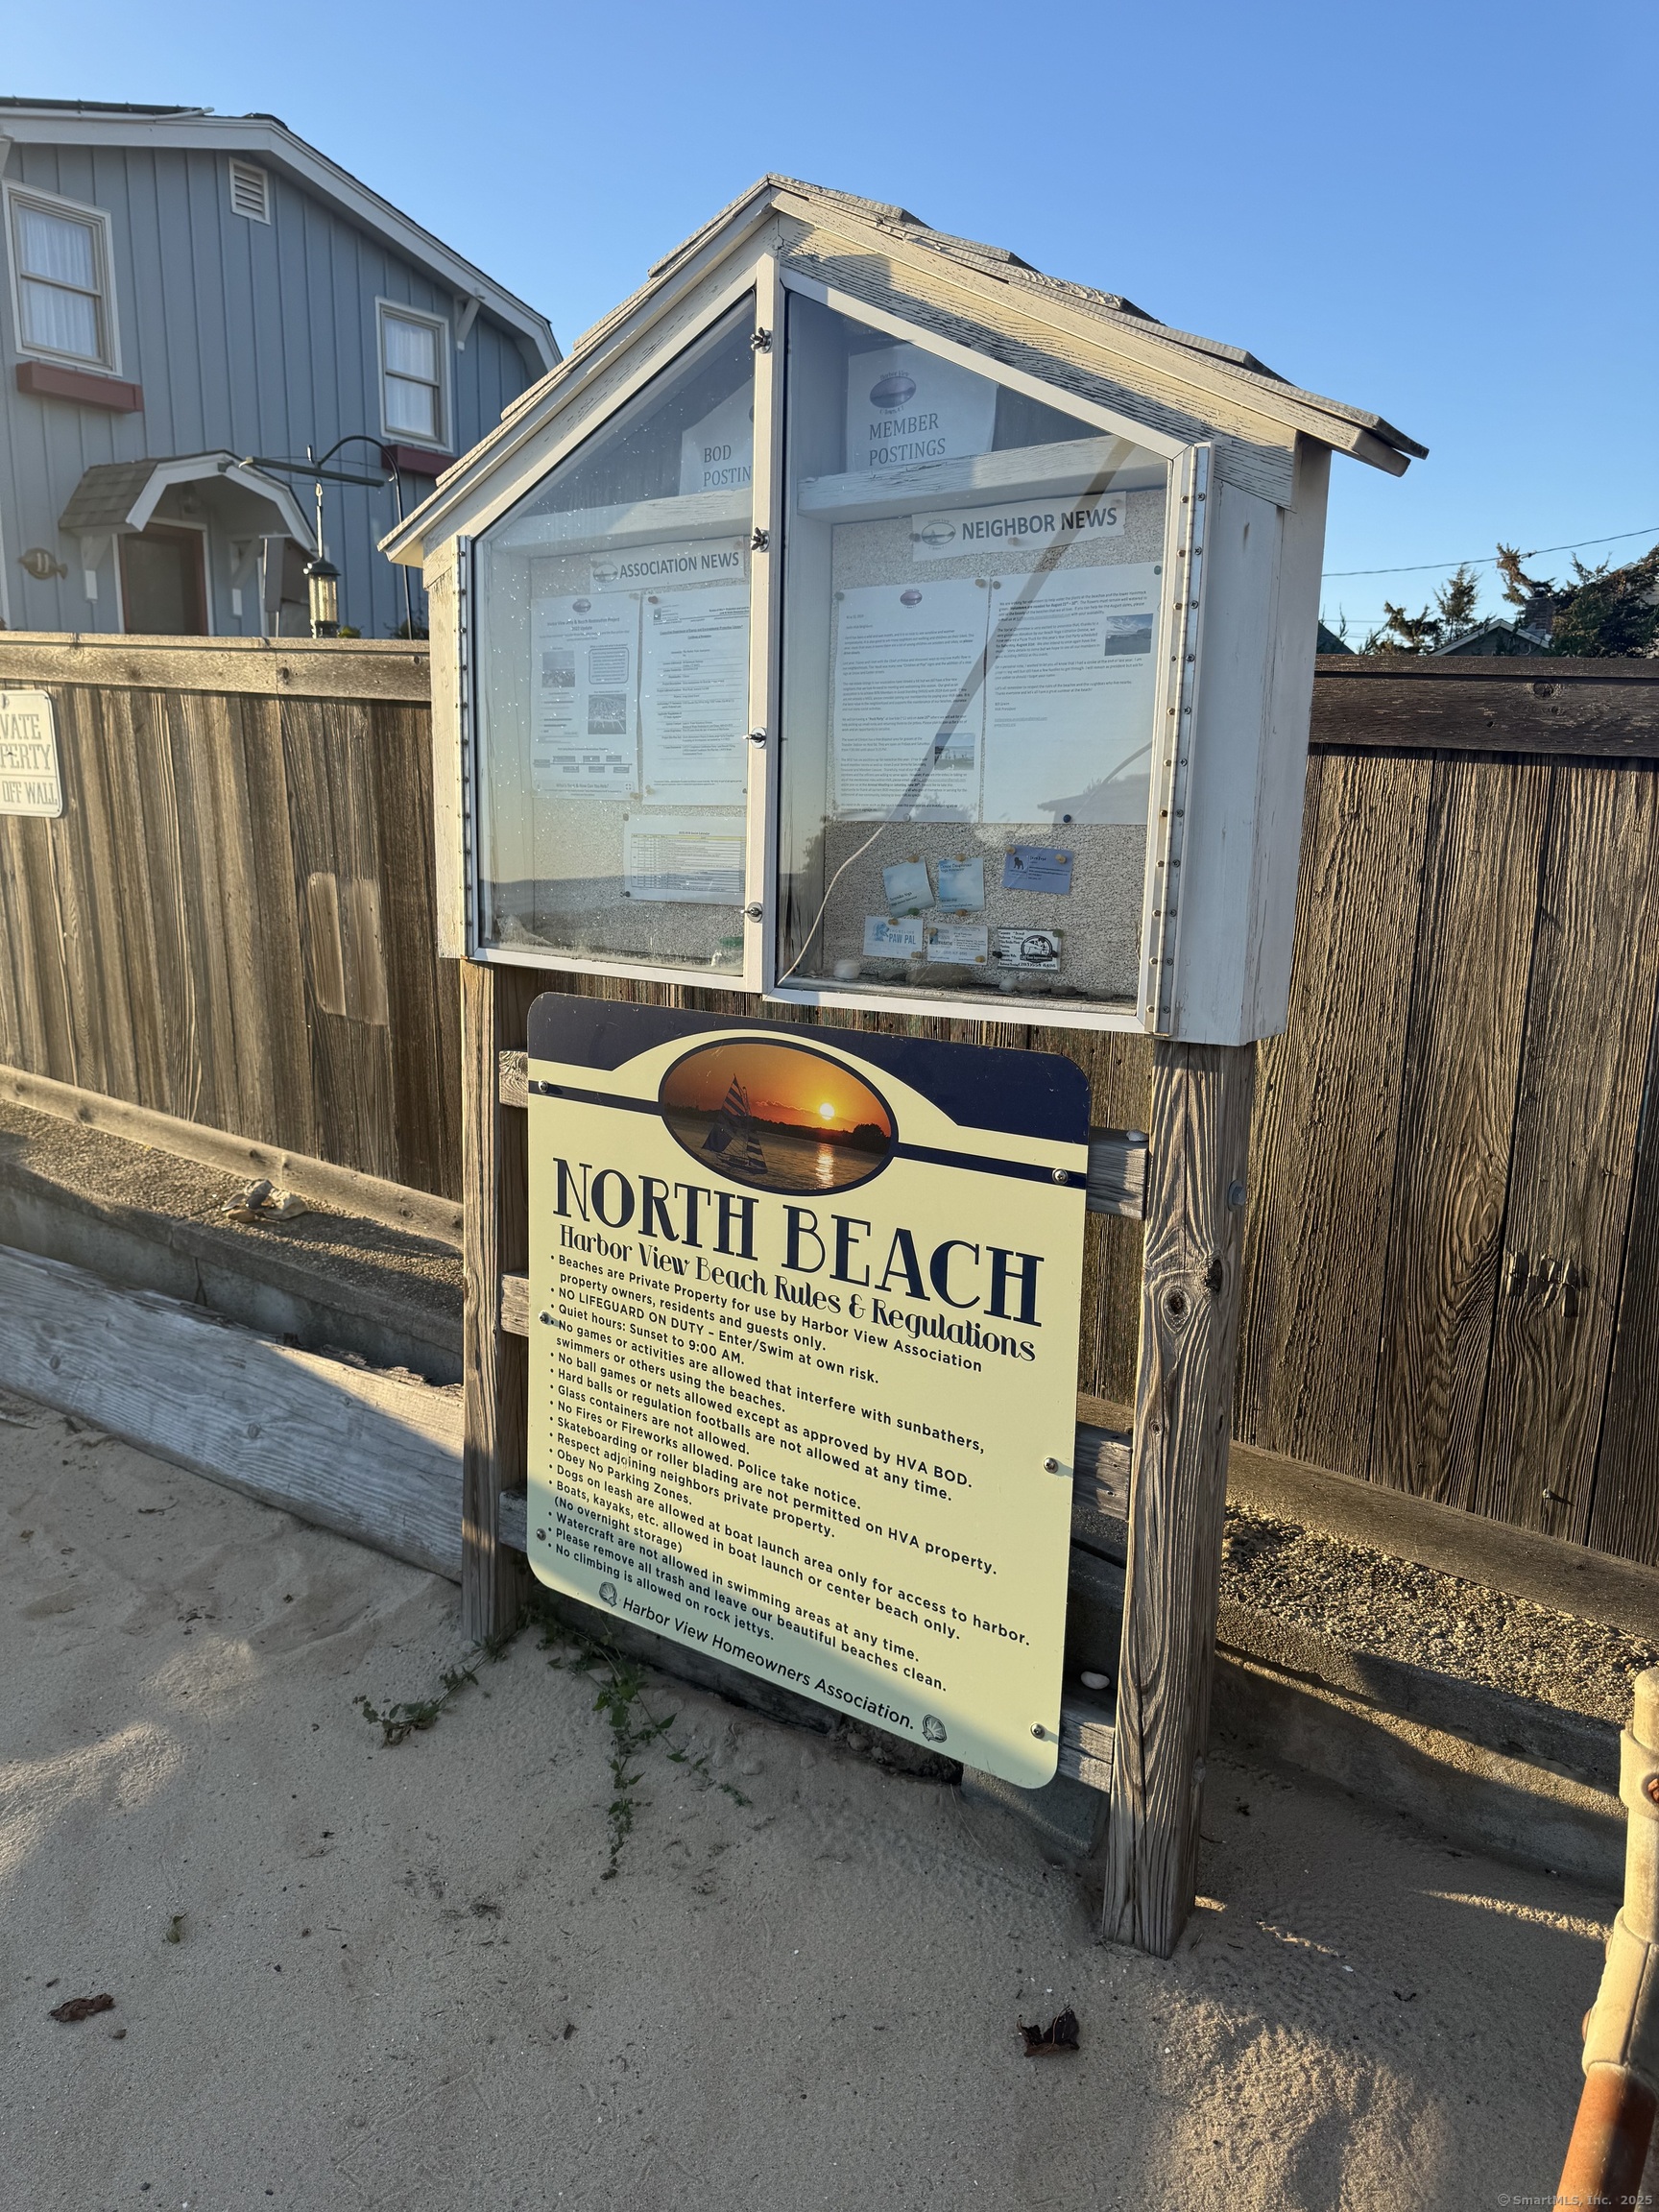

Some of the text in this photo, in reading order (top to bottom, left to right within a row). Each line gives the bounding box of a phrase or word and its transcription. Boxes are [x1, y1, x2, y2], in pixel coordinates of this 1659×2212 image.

[704, 445, 732, 463] BOD
[869, 438, 946, 467] POSTINGS
[870, 413, 939, 441] MEMBER
[704, 466, 753, 487] POSTIN
[962, 507, 1118, 541] NEIGHBOR NEWS
[619, 552, 739, 579] ASSOCIATION NEWS
[0, 713, 41, 740] VATE
[0, 743, 51, 771] PERTY
[2, 781, 58, 805] OFF WALL
[889, 933, 916, 945] PAW PAL
[552, 1156, 1045, 1328] NORTH BEACH
[558, 1253, 982, 1373] Beaches are Private Property for use by Harbor View Association
[559, 1222, 1036, 1362] Harbor View Beach Rules & Regulations
[559, 1272, 827, 1352] property owners, residents and guests only.
[558, 1303, 745, 1365] Quiet hours: Sunset to 9:00 AM.
[558, 1286, 575, 1301] NO
[578, 1291, 645, 1319] LIFEGUARD
[647, 1310, 666, 1326] ON
[670, 1316, 705, 1335] DUTY
[718, 1329, 794, 1361] Enter/Swim
[797, 1353, 812, 1366] at
[815, 1358, 845, 1375] own
[849, 1365, 878, 1384] risk.
[555, 1336, 785, 1413] swimmers or others using the beaches.
[558, 1319, 984, 1455] No games or activities are allowed that interfere with sunbathers,
[557, 1383, 750, 1455] Glass containers are not allowed.
[558, 1351, 973, 1488] No ball games or nets allowed except as approved by HVA BOD.
[556, 1448, 692, 1505] Obey No Parking Zones.
[557, 1431, 835, 1538] Respect adjoining neighbors private property.
[557, 1415, 997, 1575] Skateboarding or roller blading are not permitted on HVA property.
[554, 1495, 683, 1553] (No overnight storage)
[556, 1463, 1030, 1647] Dogs on leash are allowed at boat launch area only for access to harbor.
[555, 1510, 919, 1663] Watercraft are not allowed in swimming areas at any time.
[555, 1542, 774, 1641] No climbing is allowed on rock jettys.
[622, 1596, 914, 1730] Harbor View Homeowners Association.
